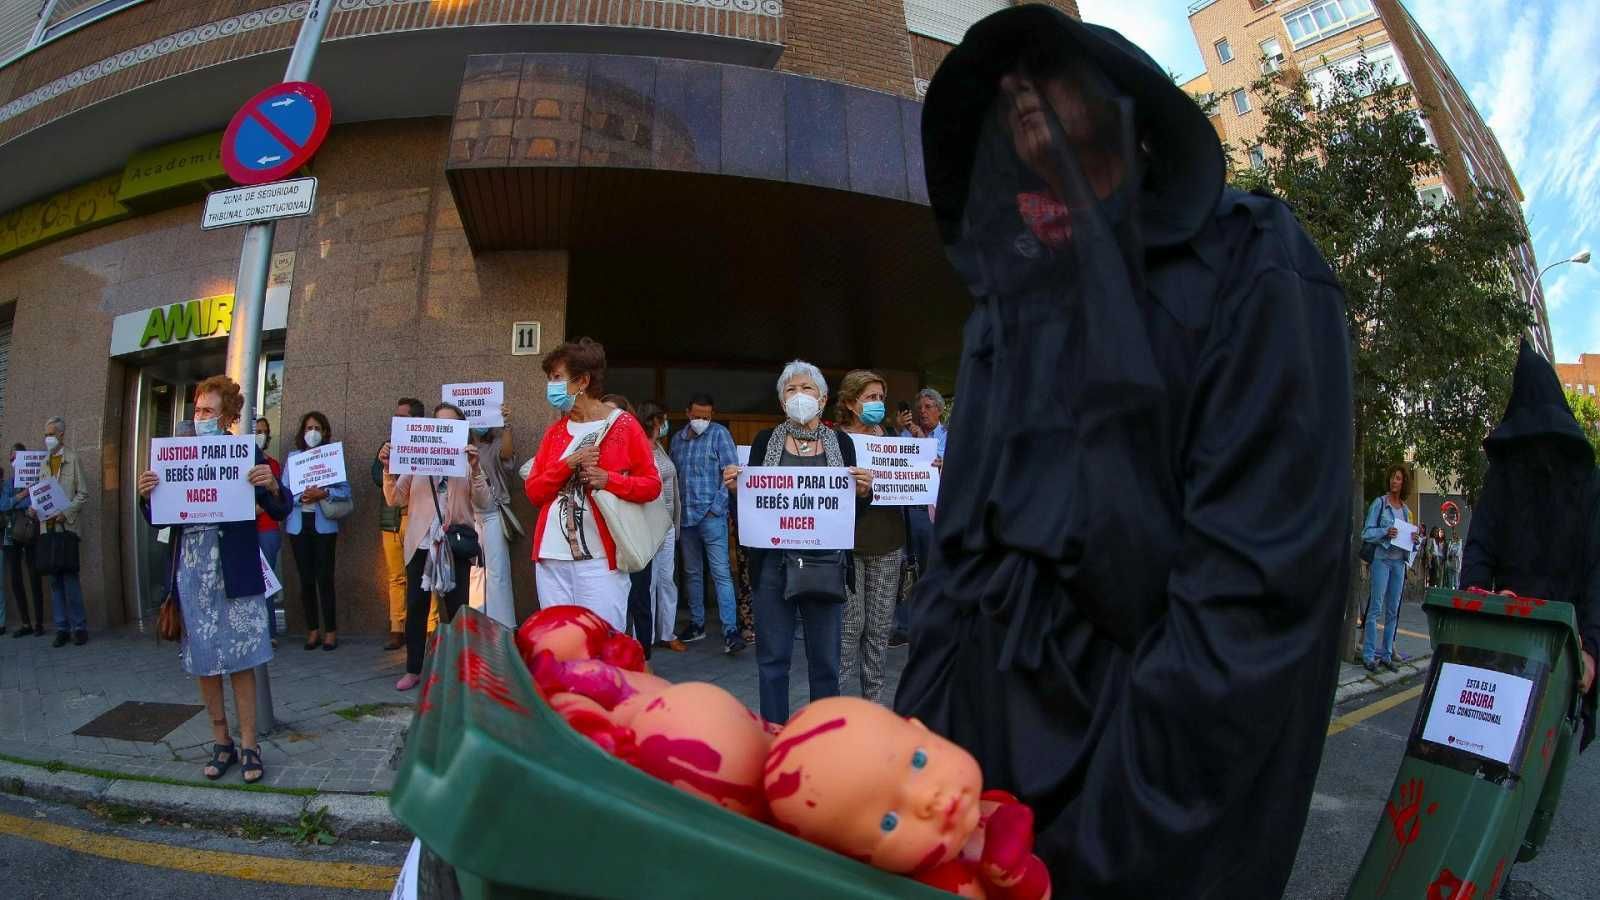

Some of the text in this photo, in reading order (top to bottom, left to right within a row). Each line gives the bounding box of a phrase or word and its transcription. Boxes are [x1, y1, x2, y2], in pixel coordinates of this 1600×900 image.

[223, 186, 299, 205] ZONA DE SEGURIDAD
[208, 201, 308, 222] TRIBUNAL CONSTITUCIONAL
[140, 294, 235, 347] AMIR
[518, 328, 533, 348] 11
[452, 387, 493, 396] MAGISTRADOS:
[458, 398, 485, 407] DÉJENLOS
[463, 409, 482, 417] NACER
[436, 424, 454, 433] BEBÉS
[157, 444, 248, 461] JUSTICIA PARA LOS
[397, 445, 460, 456] ESPERANDO SENTENCIA
[899, 443, 920, 454] BEBÉS
[399, 456, 456, 466] DEL CONSTITUCIONAL
[166, 464, 239, 482] BEBÉS AÚN POR
[894, 471, 931, 480] SENTENCIA
[746, 475, 849, 489] JUSTICIA PARA LOS
[873, 483, 928, 493] CONSTITUCIONAL
[186, 488, 218, 503] NACER
[756, 493, 839, 510] BEBÉS AÚN POR
[779, 516, 815, 530] NACER
[1466, 678, 1497, 693] ESTA ES LA
[1459, 689, 1495, 710] BASURA
[1446, 704, 1502, 725] DEL CONSTITUCIONAL
